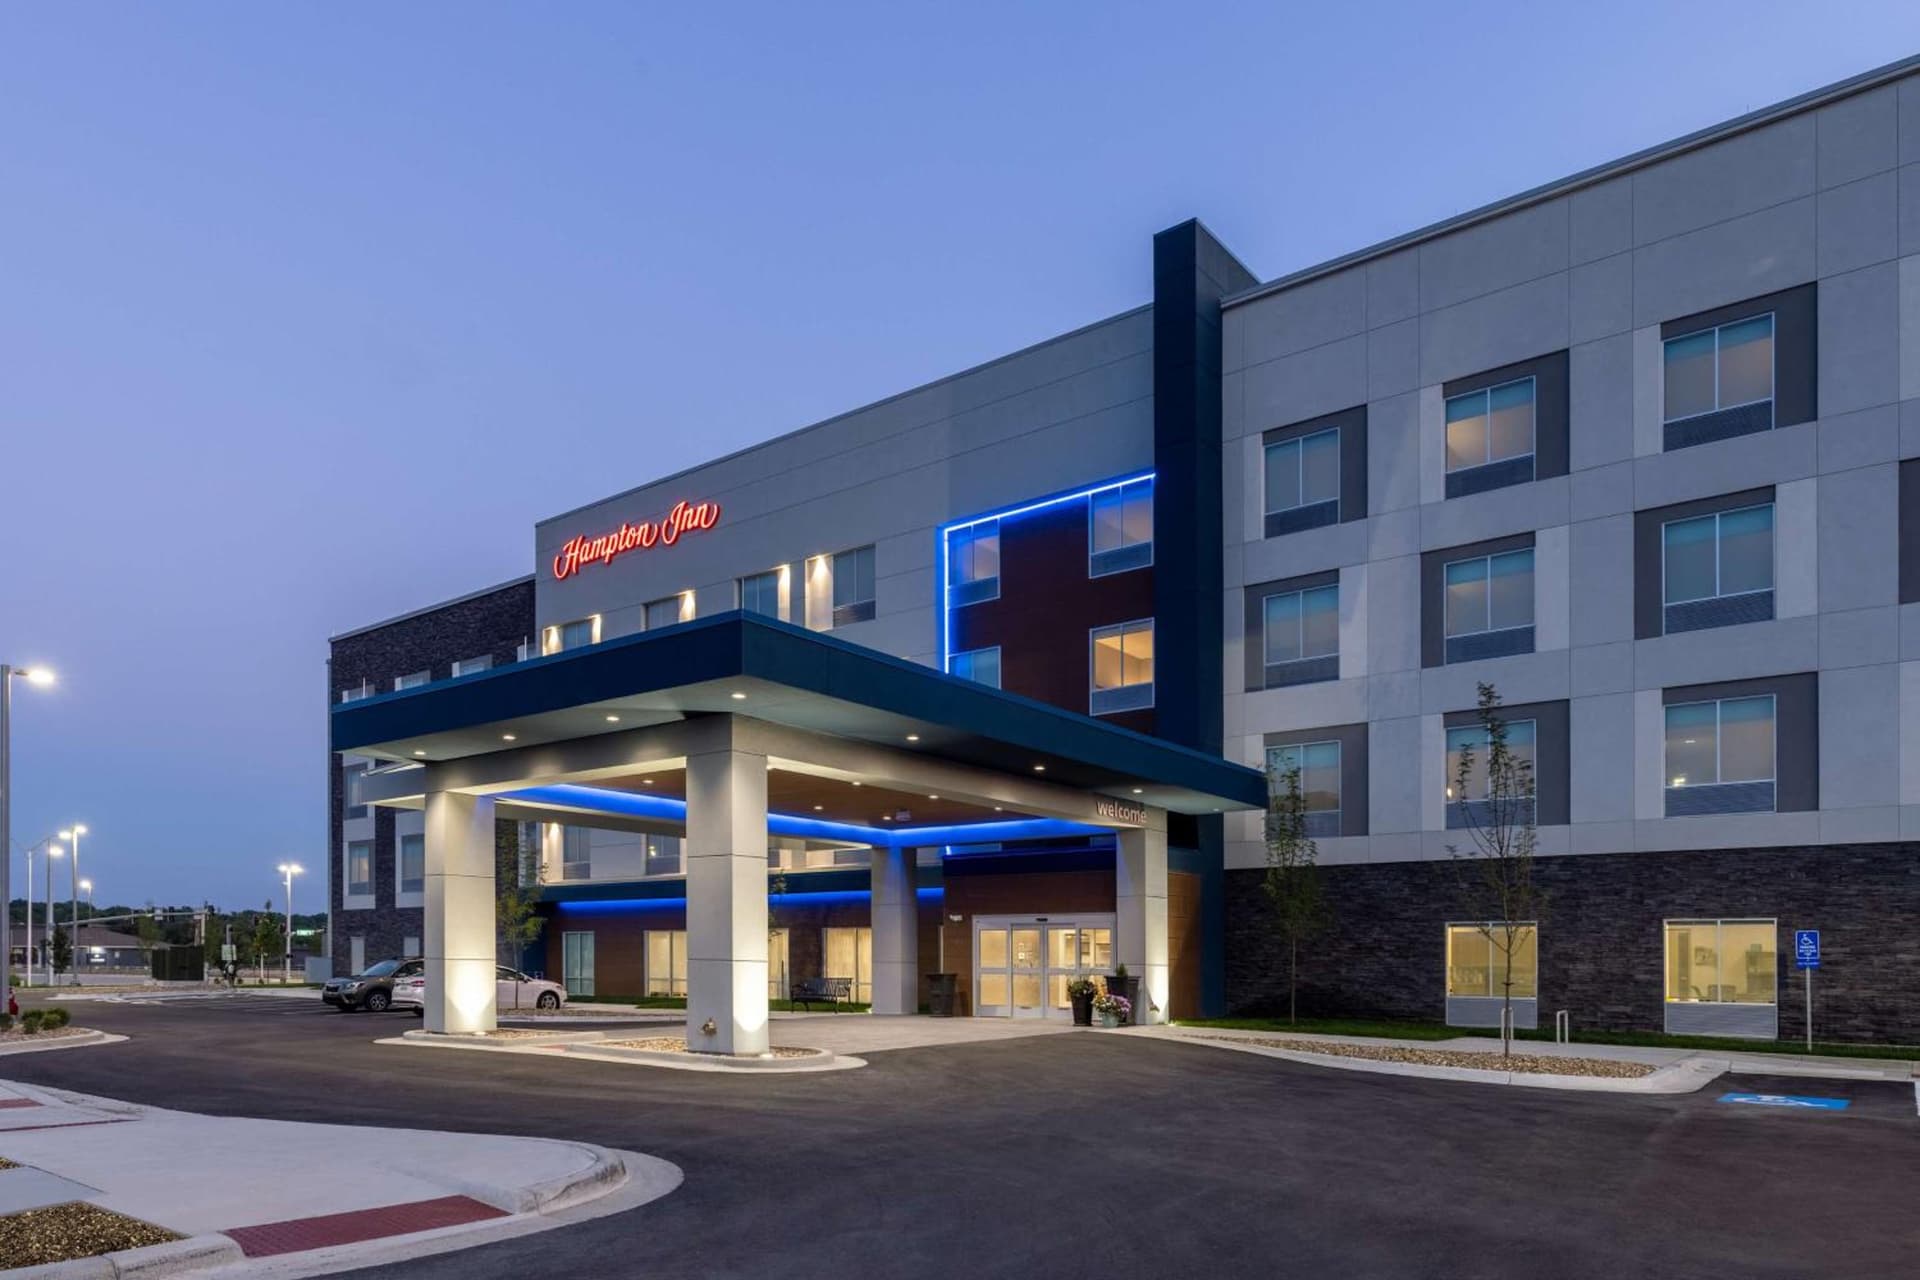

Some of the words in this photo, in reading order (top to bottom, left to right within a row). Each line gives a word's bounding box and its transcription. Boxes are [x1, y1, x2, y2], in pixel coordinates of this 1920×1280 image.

[553, 523, 658, 580] Hampton
[661, 500, 721, 545] Inn
[1096, 801, 1147, 823] welcome
